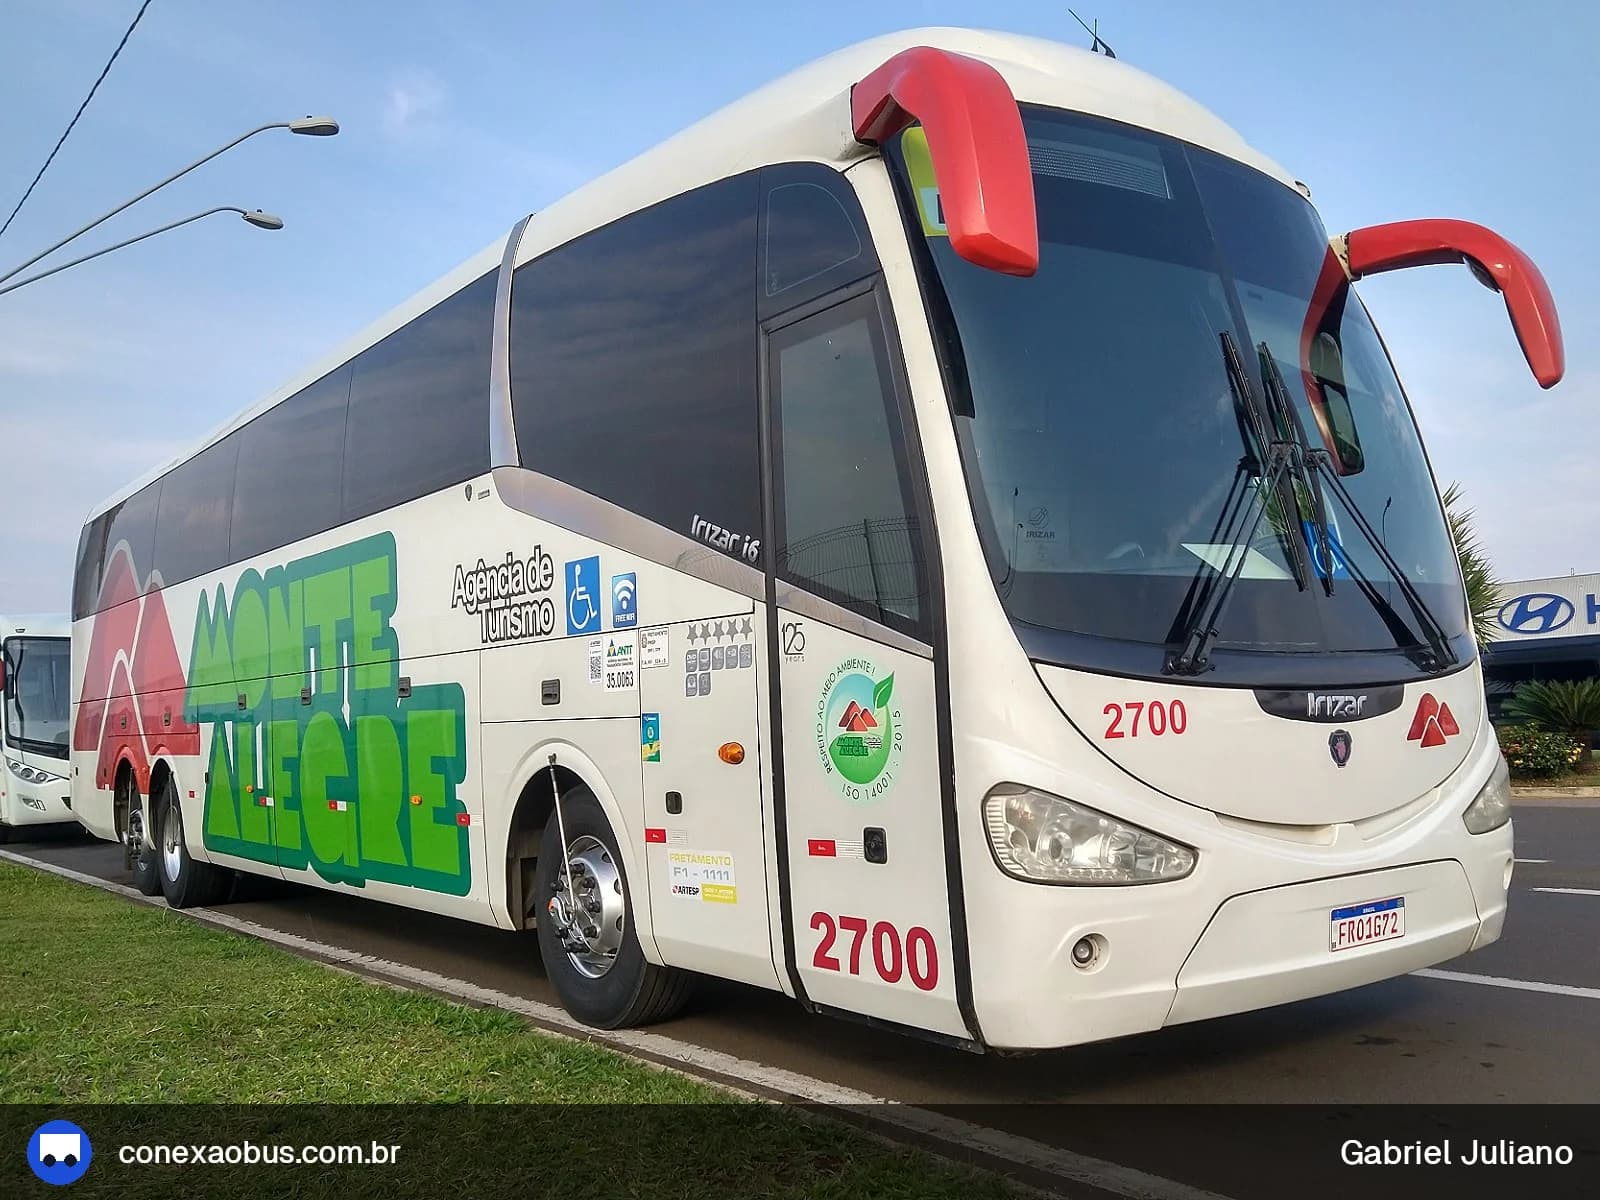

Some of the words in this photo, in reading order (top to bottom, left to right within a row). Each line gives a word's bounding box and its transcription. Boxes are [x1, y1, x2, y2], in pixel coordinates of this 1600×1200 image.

[691, 513, 741, 552] Irizar
[742, 535, 761, 563] i6
[451, 552, 526, 615] Agência
[525, 545, 554, 592] de
[184, 550, 396, 716] MONTE
[477, 597, 555, 643] Turismo
[616, 645, 633, 656] ANTT
[606, 670, 634, 688] 35.0063
[822, 673, 836, 699] MEIO
[817, 700, 825, 720] AO
[1103, 699, 1187, 739] 2700
[1307, 692, 1367, 717] Irizar
[817, 723, 833, 774] RESPEITO
[842, 783, 860, 800] ISO
[865, 771, 893, 800] 14001
[893, 710, 903, 752] 2015
[204, 708, 463, 880] ALEGRE
[670, 853, 731, 866] FRETAMENTO
[678, 885, 700, 895] ARTESP
[809, 911, 939, 991] 2700
